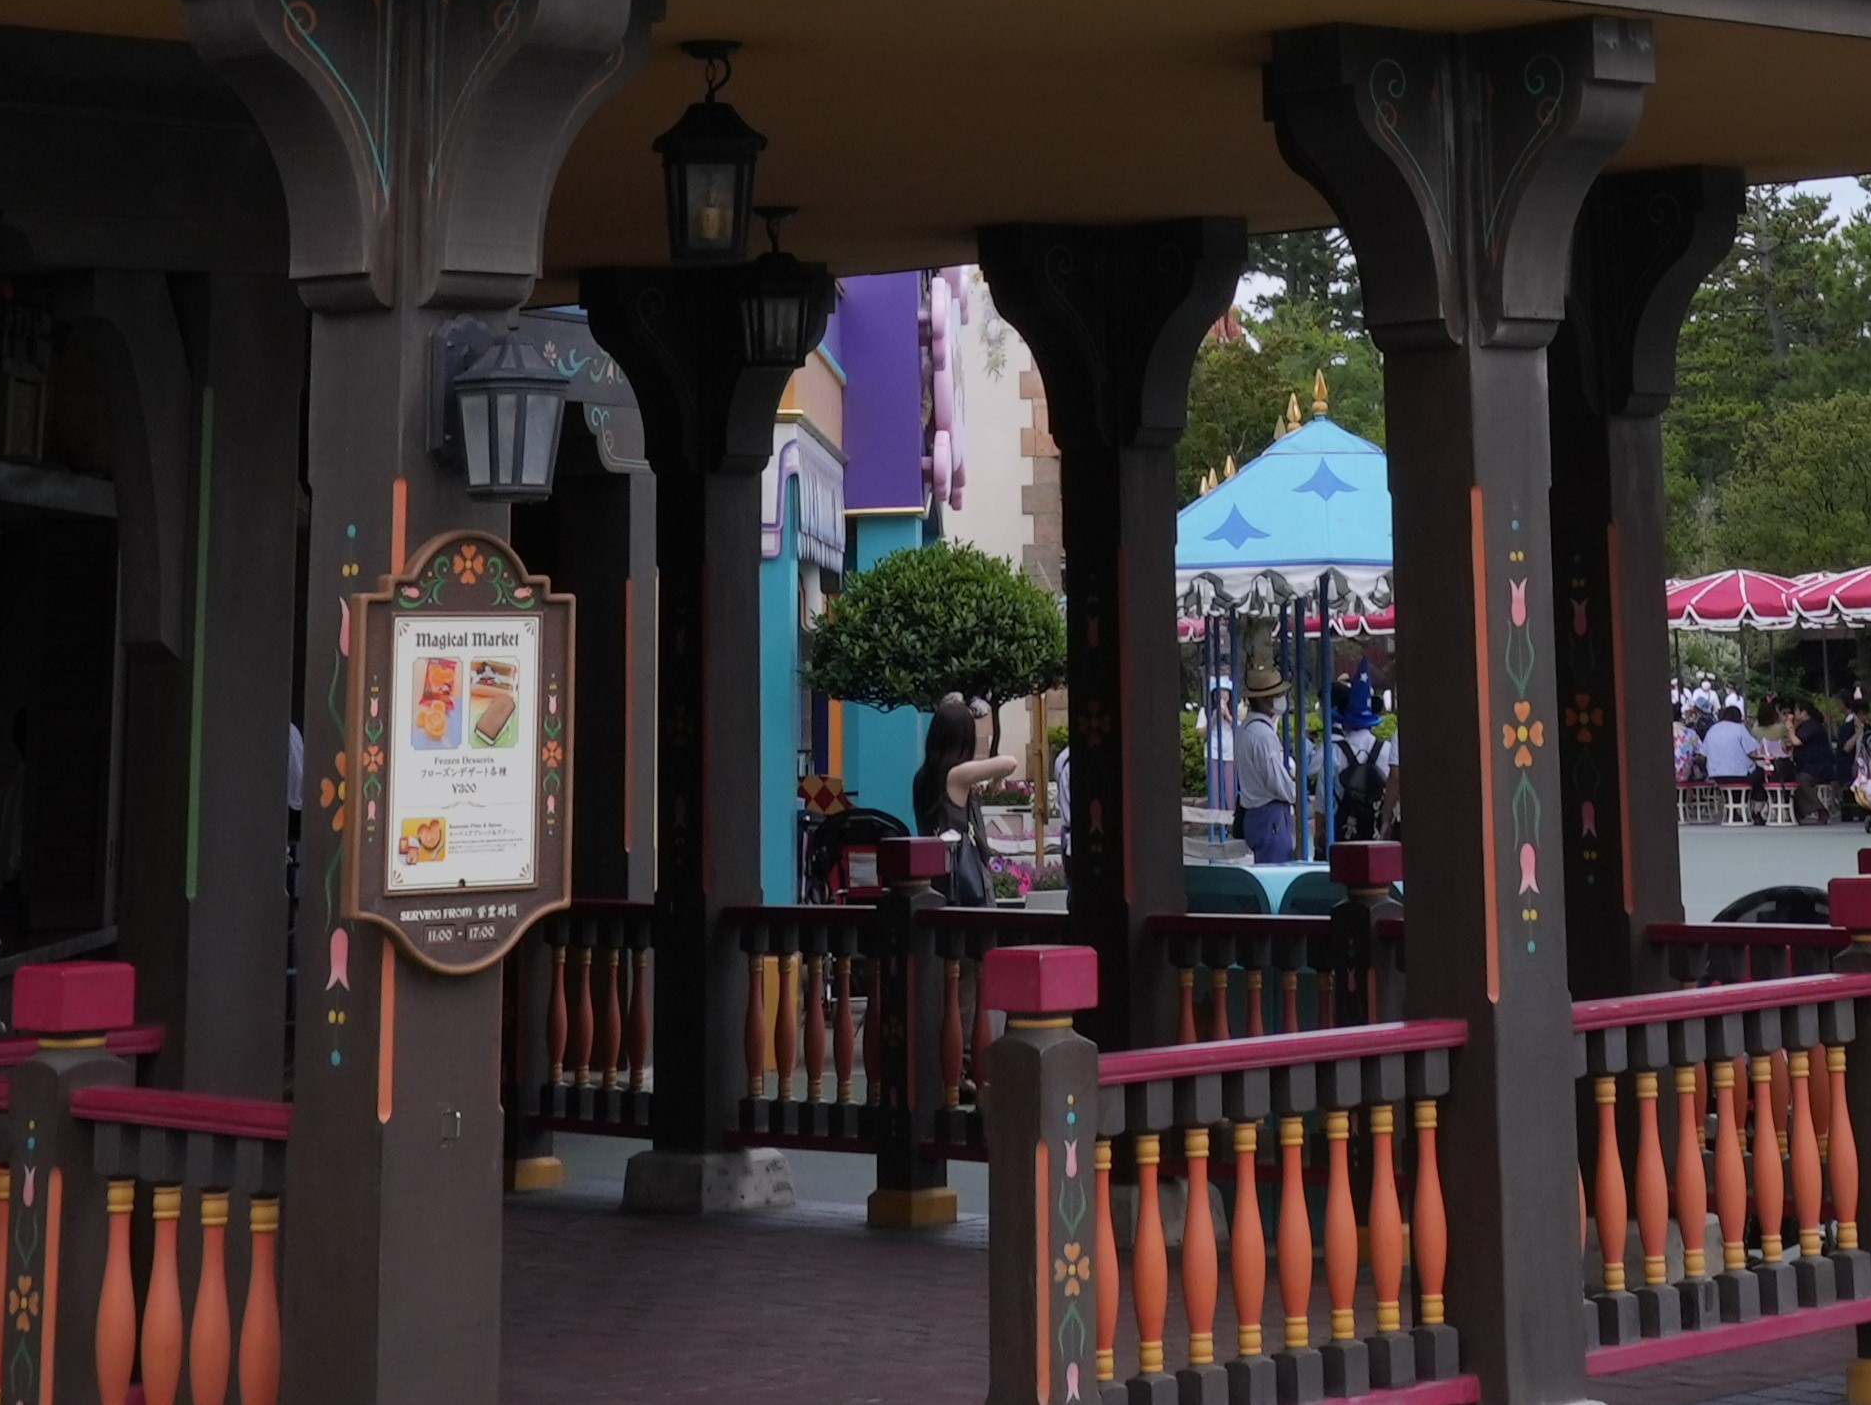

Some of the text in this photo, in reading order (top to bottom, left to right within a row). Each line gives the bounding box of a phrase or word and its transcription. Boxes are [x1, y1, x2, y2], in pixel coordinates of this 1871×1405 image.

[415, 631, 519, 650] Magical Market
[399, 909, 442, 922] SERVING
[442, 907, 473, 919] FROM
[427, 929, 453, 943] 11:00
[468, 925, 496, 940] 17:00
